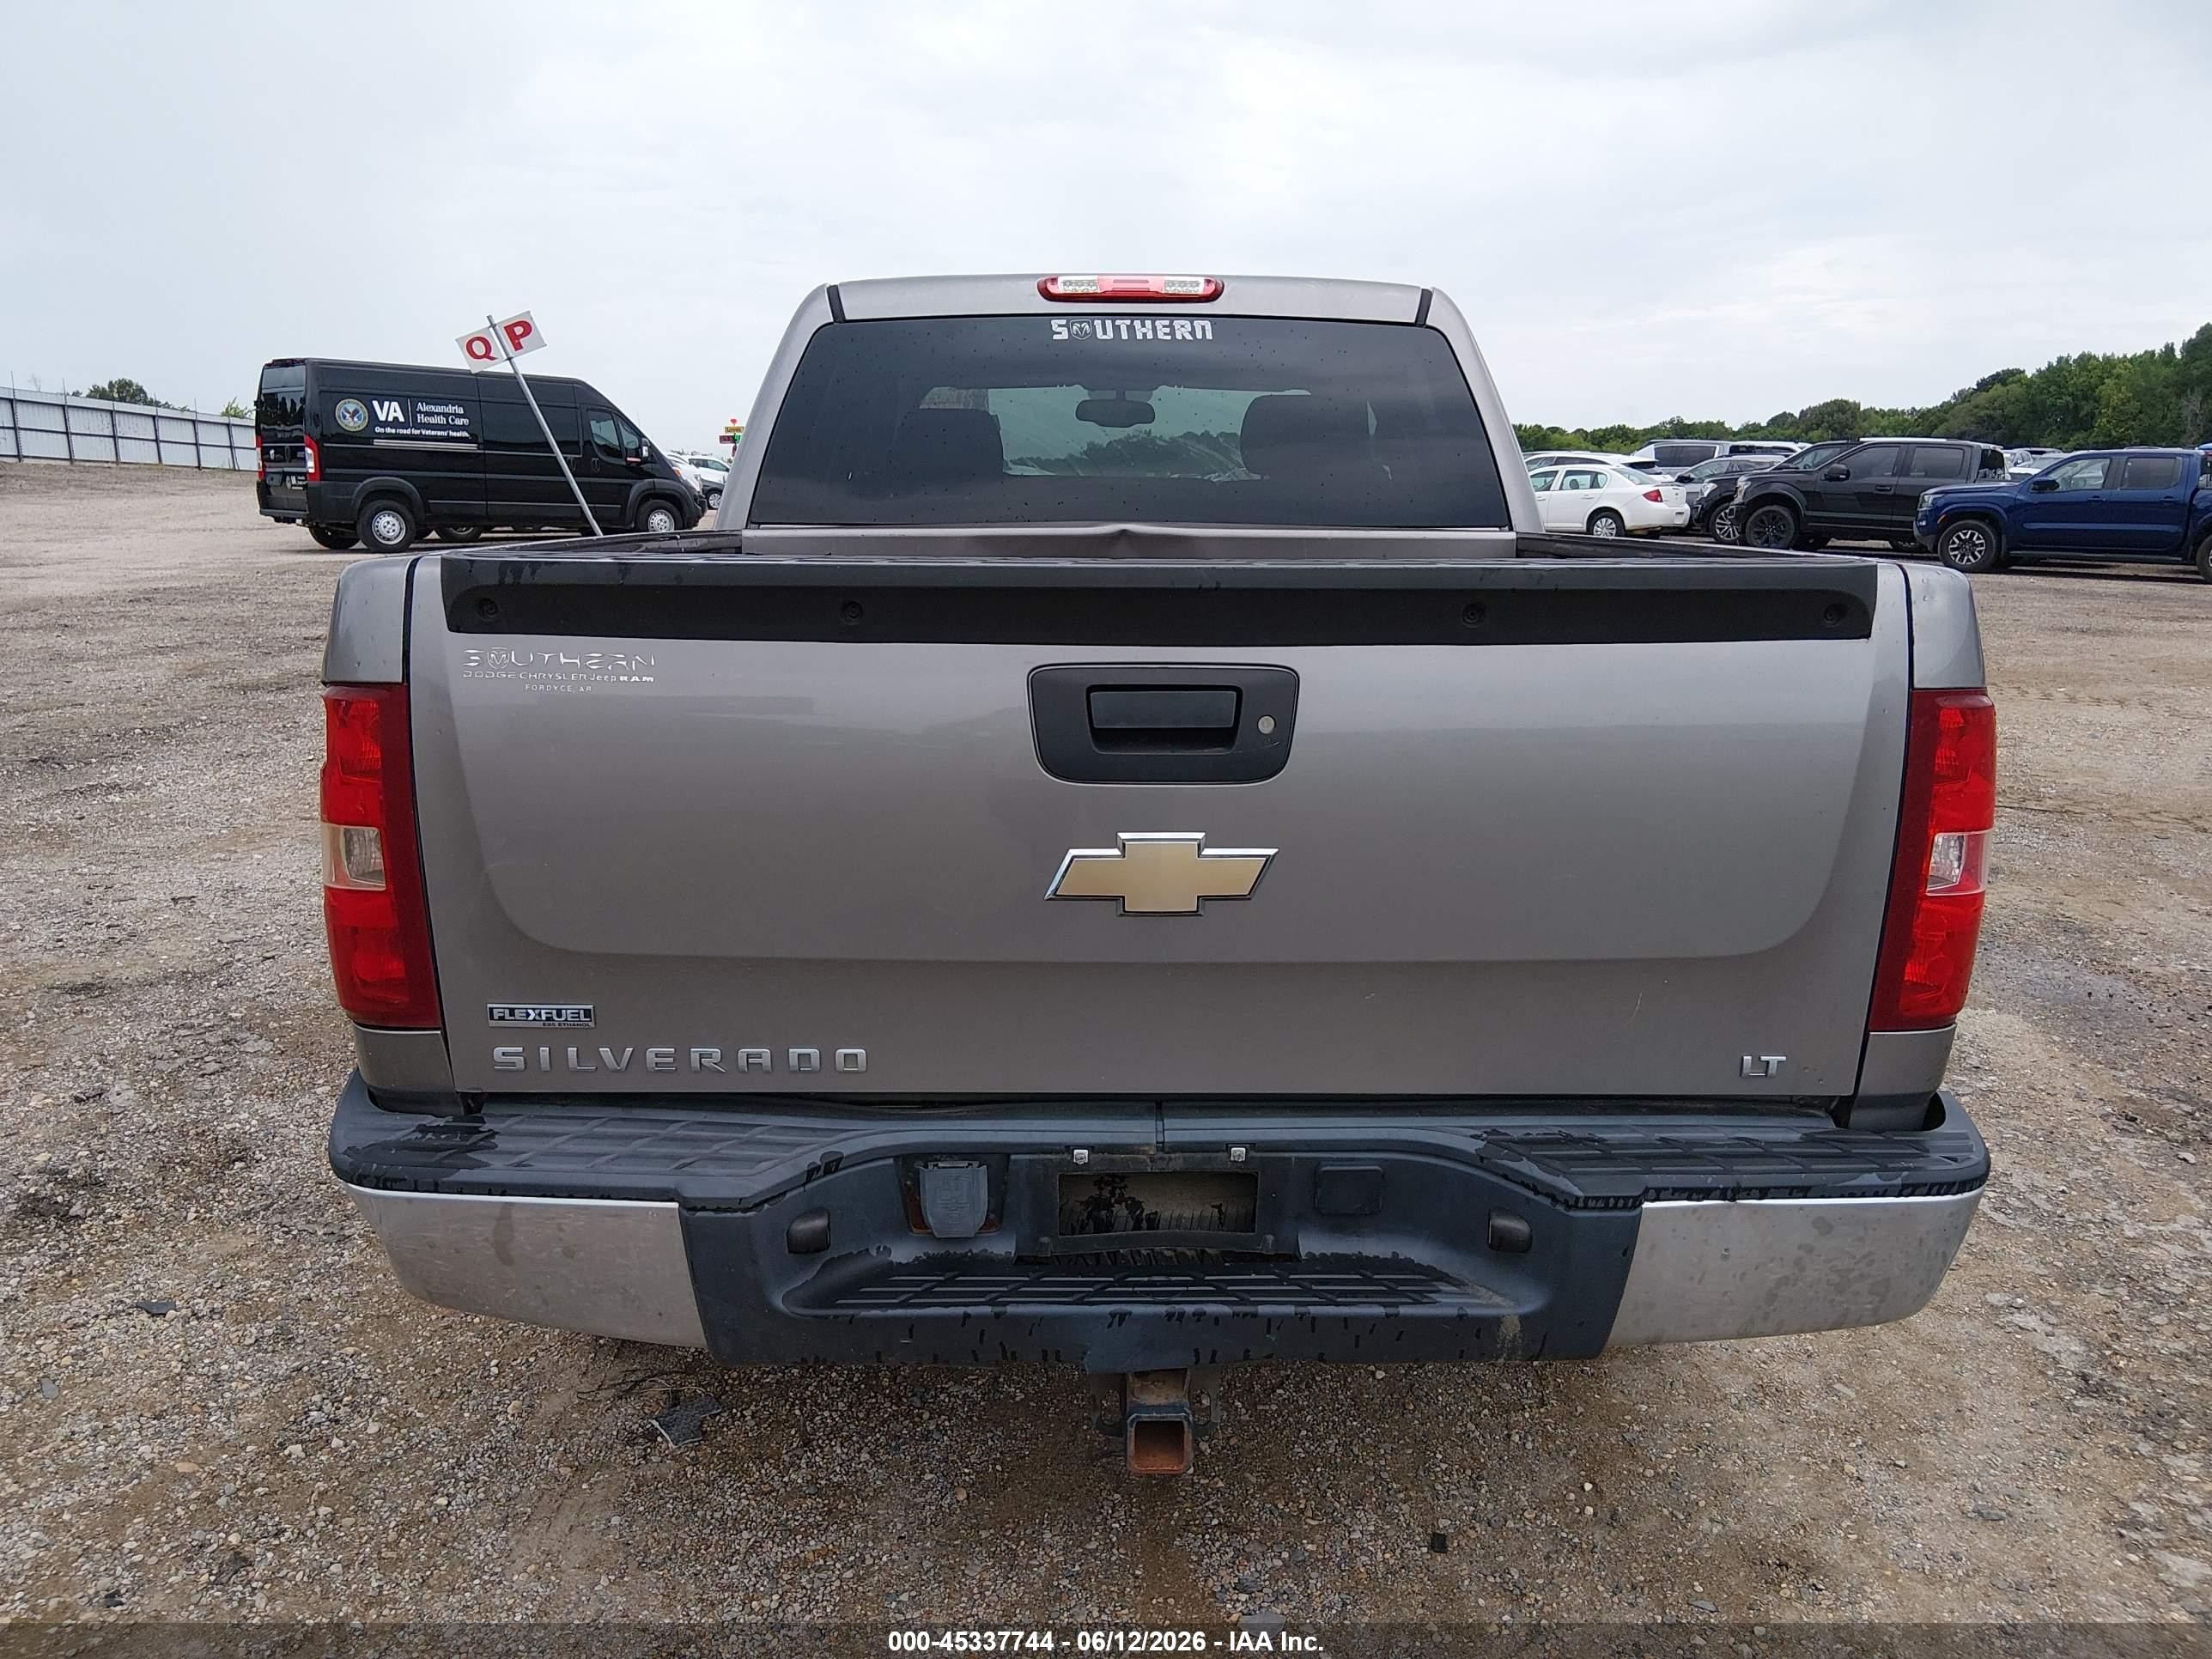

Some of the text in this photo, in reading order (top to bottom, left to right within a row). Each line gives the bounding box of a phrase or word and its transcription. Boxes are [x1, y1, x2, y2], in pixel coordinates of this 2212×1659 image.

[503, 320, 532, 351] P
[466, 336, 498, 361] Q
[372, 400, 405, 422] VA
[416, 402, 465, 414] Alexandria
[416, 413, 470, 426] Health Care
[385, 426, 396, 434] the
[463, 670, 516, 679] DODGE
[520, 672, 587, 681] CHRYSLER
[590, 672, 617, 683] Jeep
[525, 684, 573, 692] FORDYCE
[492, 1008, 592, 1022] FLEXFUEL
[493, 1047, 868, 1073] SILVERADO
[1740, 1054, 1787, 1078] LT
